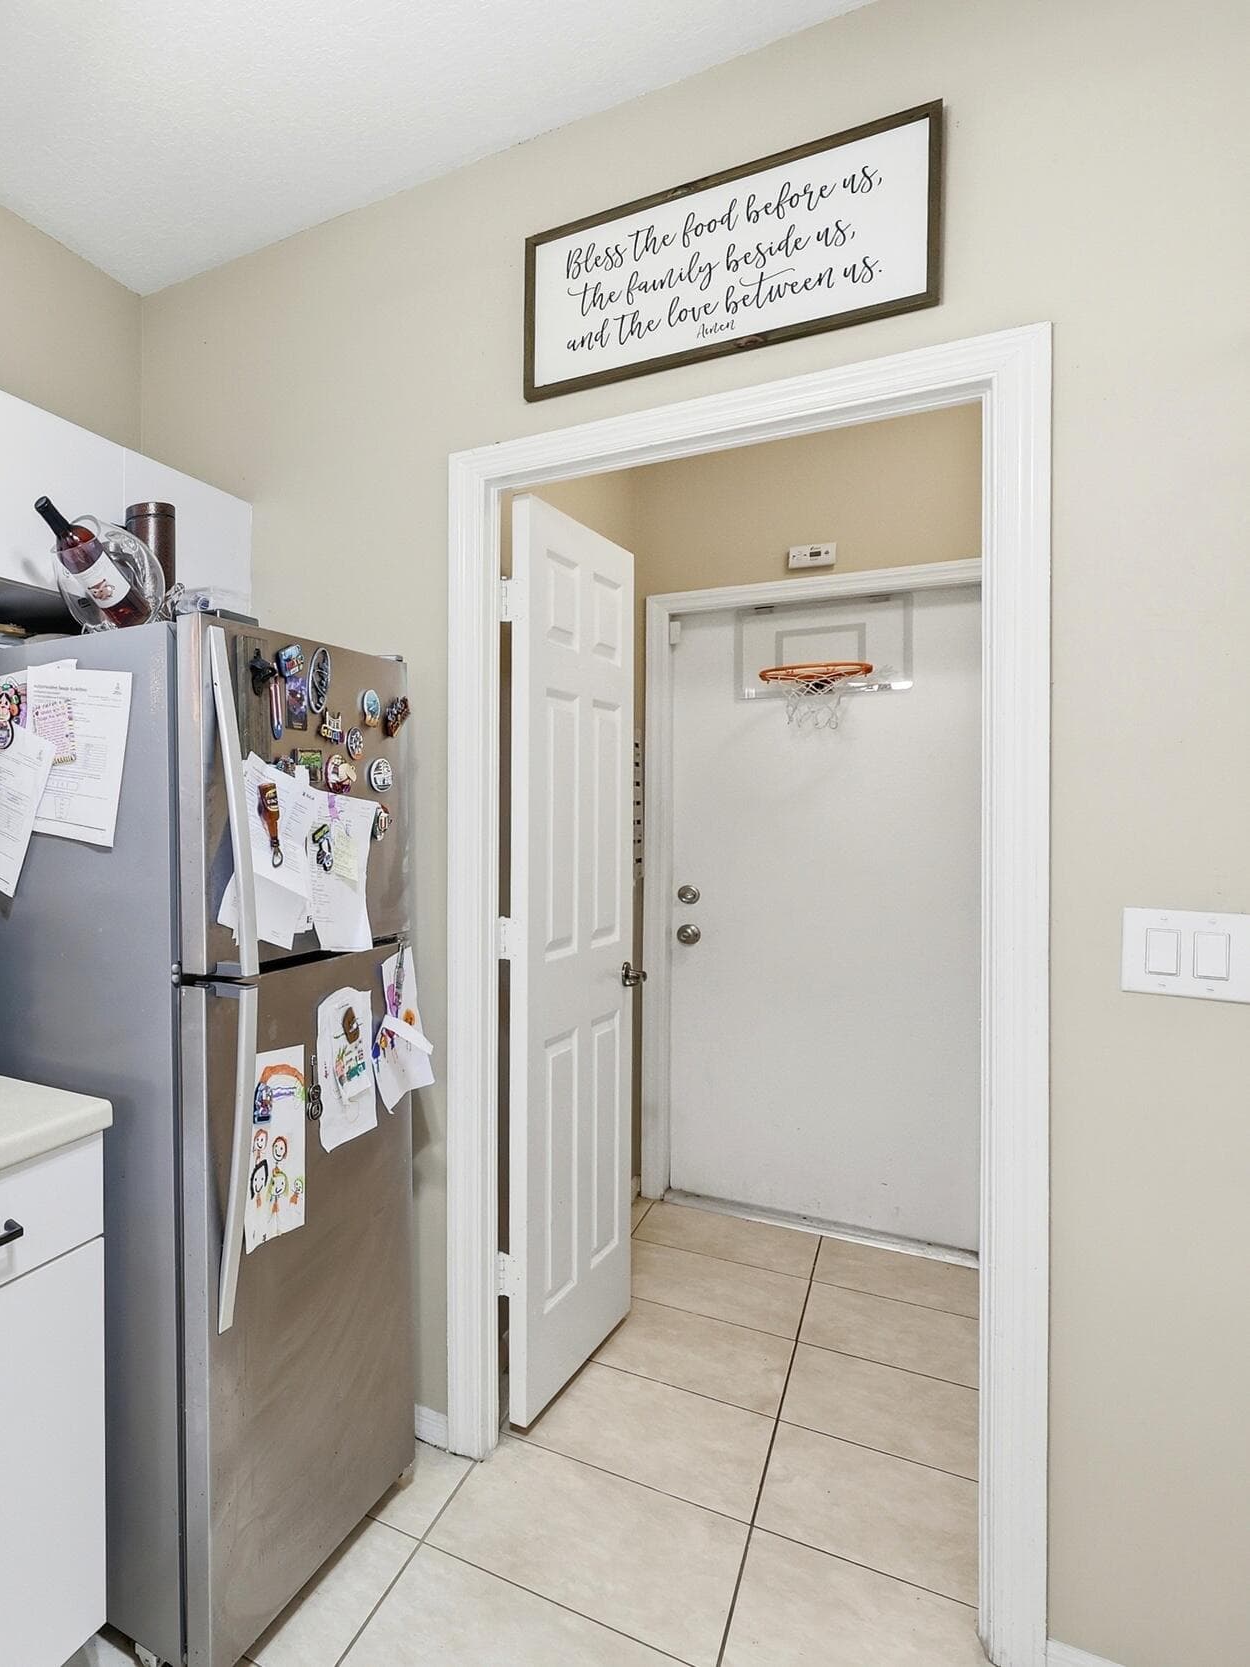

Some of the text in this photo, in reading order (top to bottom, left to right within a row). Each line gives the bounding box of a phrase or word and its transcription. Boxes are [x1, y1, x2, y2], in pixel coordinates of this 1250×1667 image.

[566, 165, 883, 280] Bless the food before us,
[567, 219, 856, 317] the family beside us,
[566, 255, 883, 353] and the love between us.
[696, 320, 735, 339] Amen
